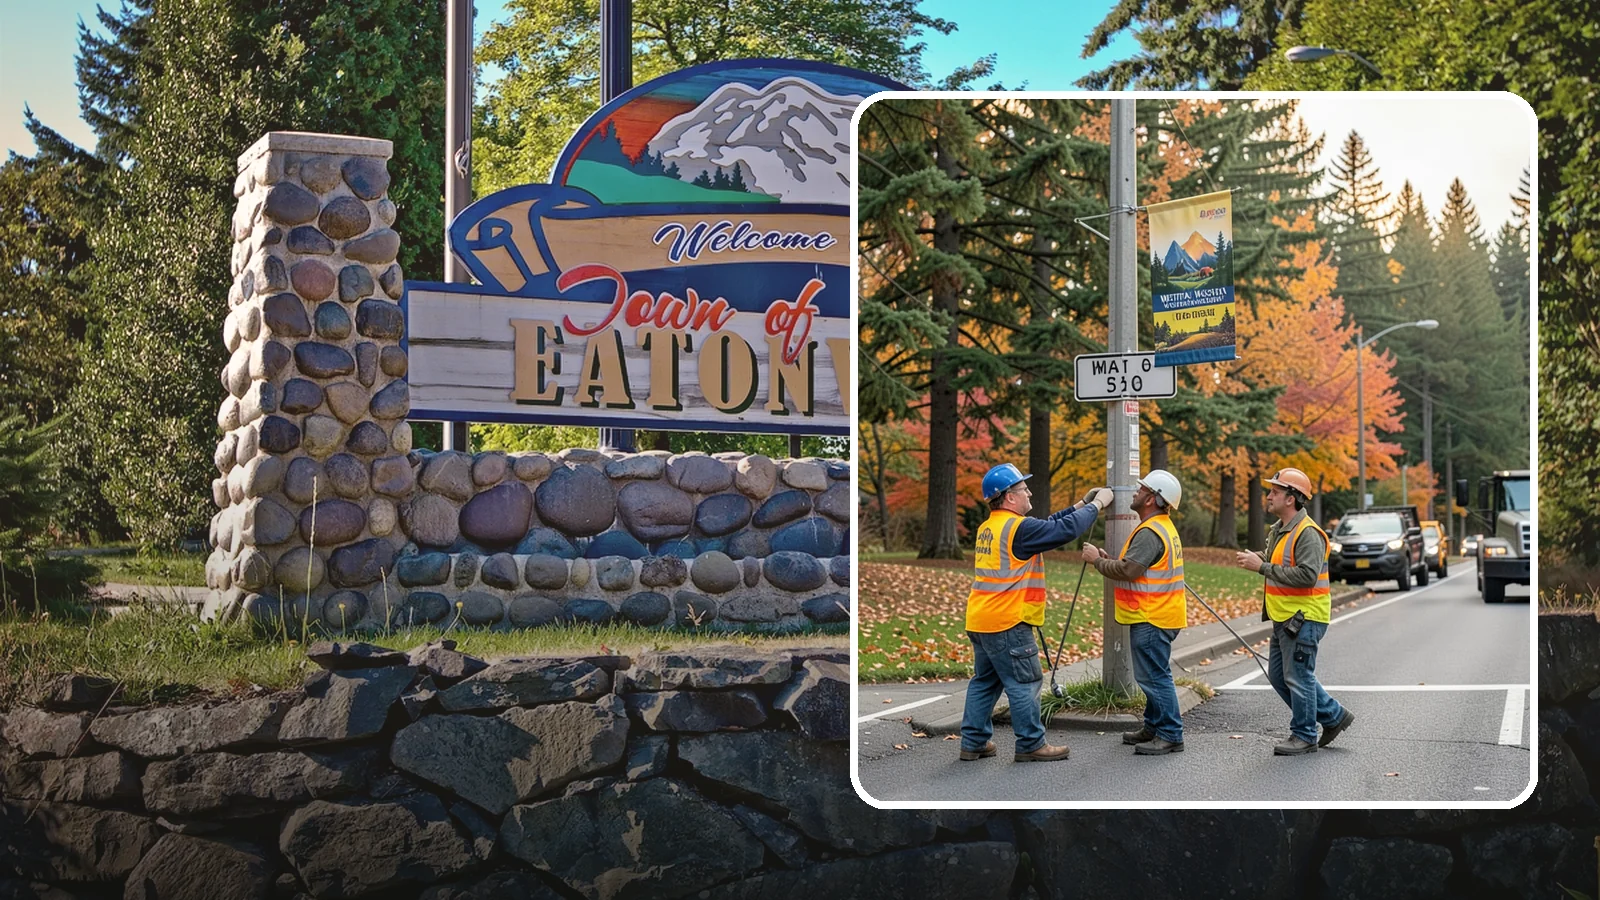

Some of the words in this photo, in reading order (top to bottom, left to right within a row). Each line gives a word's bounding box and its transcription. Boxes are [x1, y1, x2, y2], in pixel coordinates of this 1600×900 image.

[653, 221, 837, 263] Welcome
[557, 264, 736, 336] Town
[765, 278, 826, 364] of
